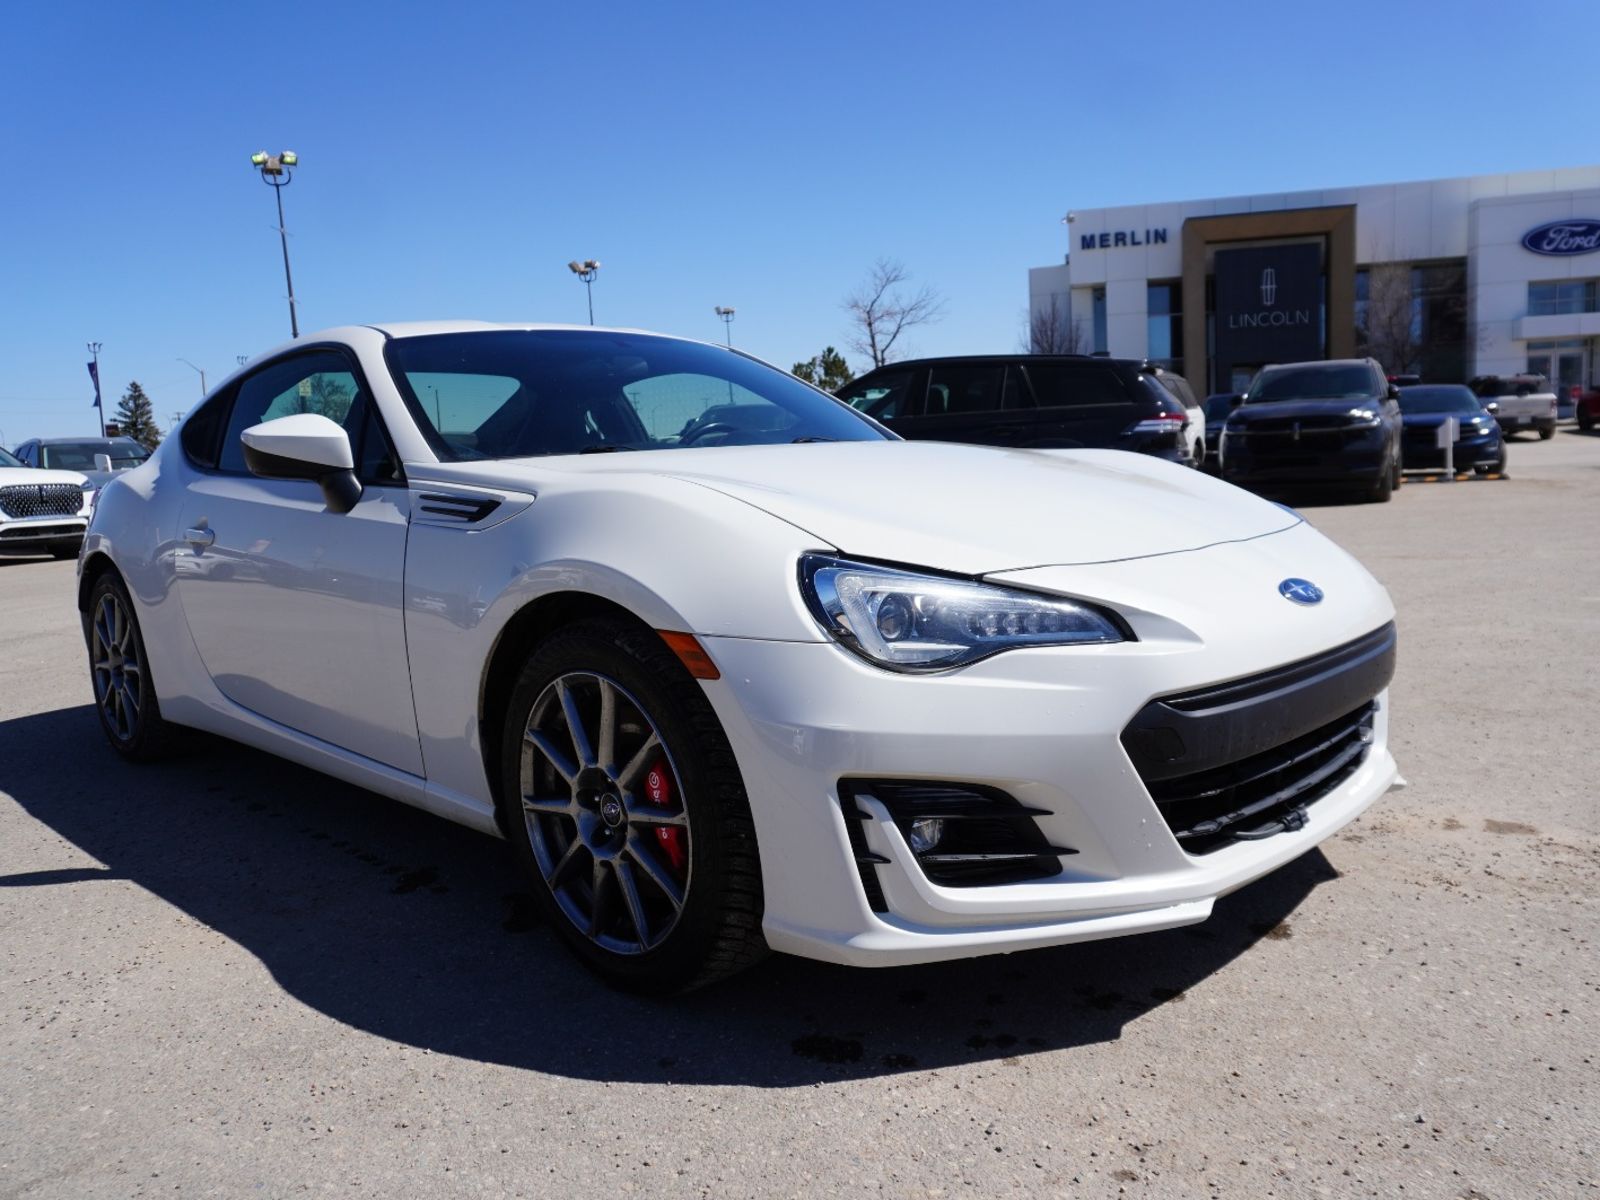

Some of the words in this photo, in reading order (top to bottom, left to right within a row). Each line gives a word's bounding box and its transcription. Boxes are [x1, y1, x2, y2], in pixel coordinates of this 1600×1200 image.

[1081, 228, 1167, 250] MERLIN
[1543, 225, 1600, 250] Ford
[1229, 310, 1309, 328] LINCOLN
